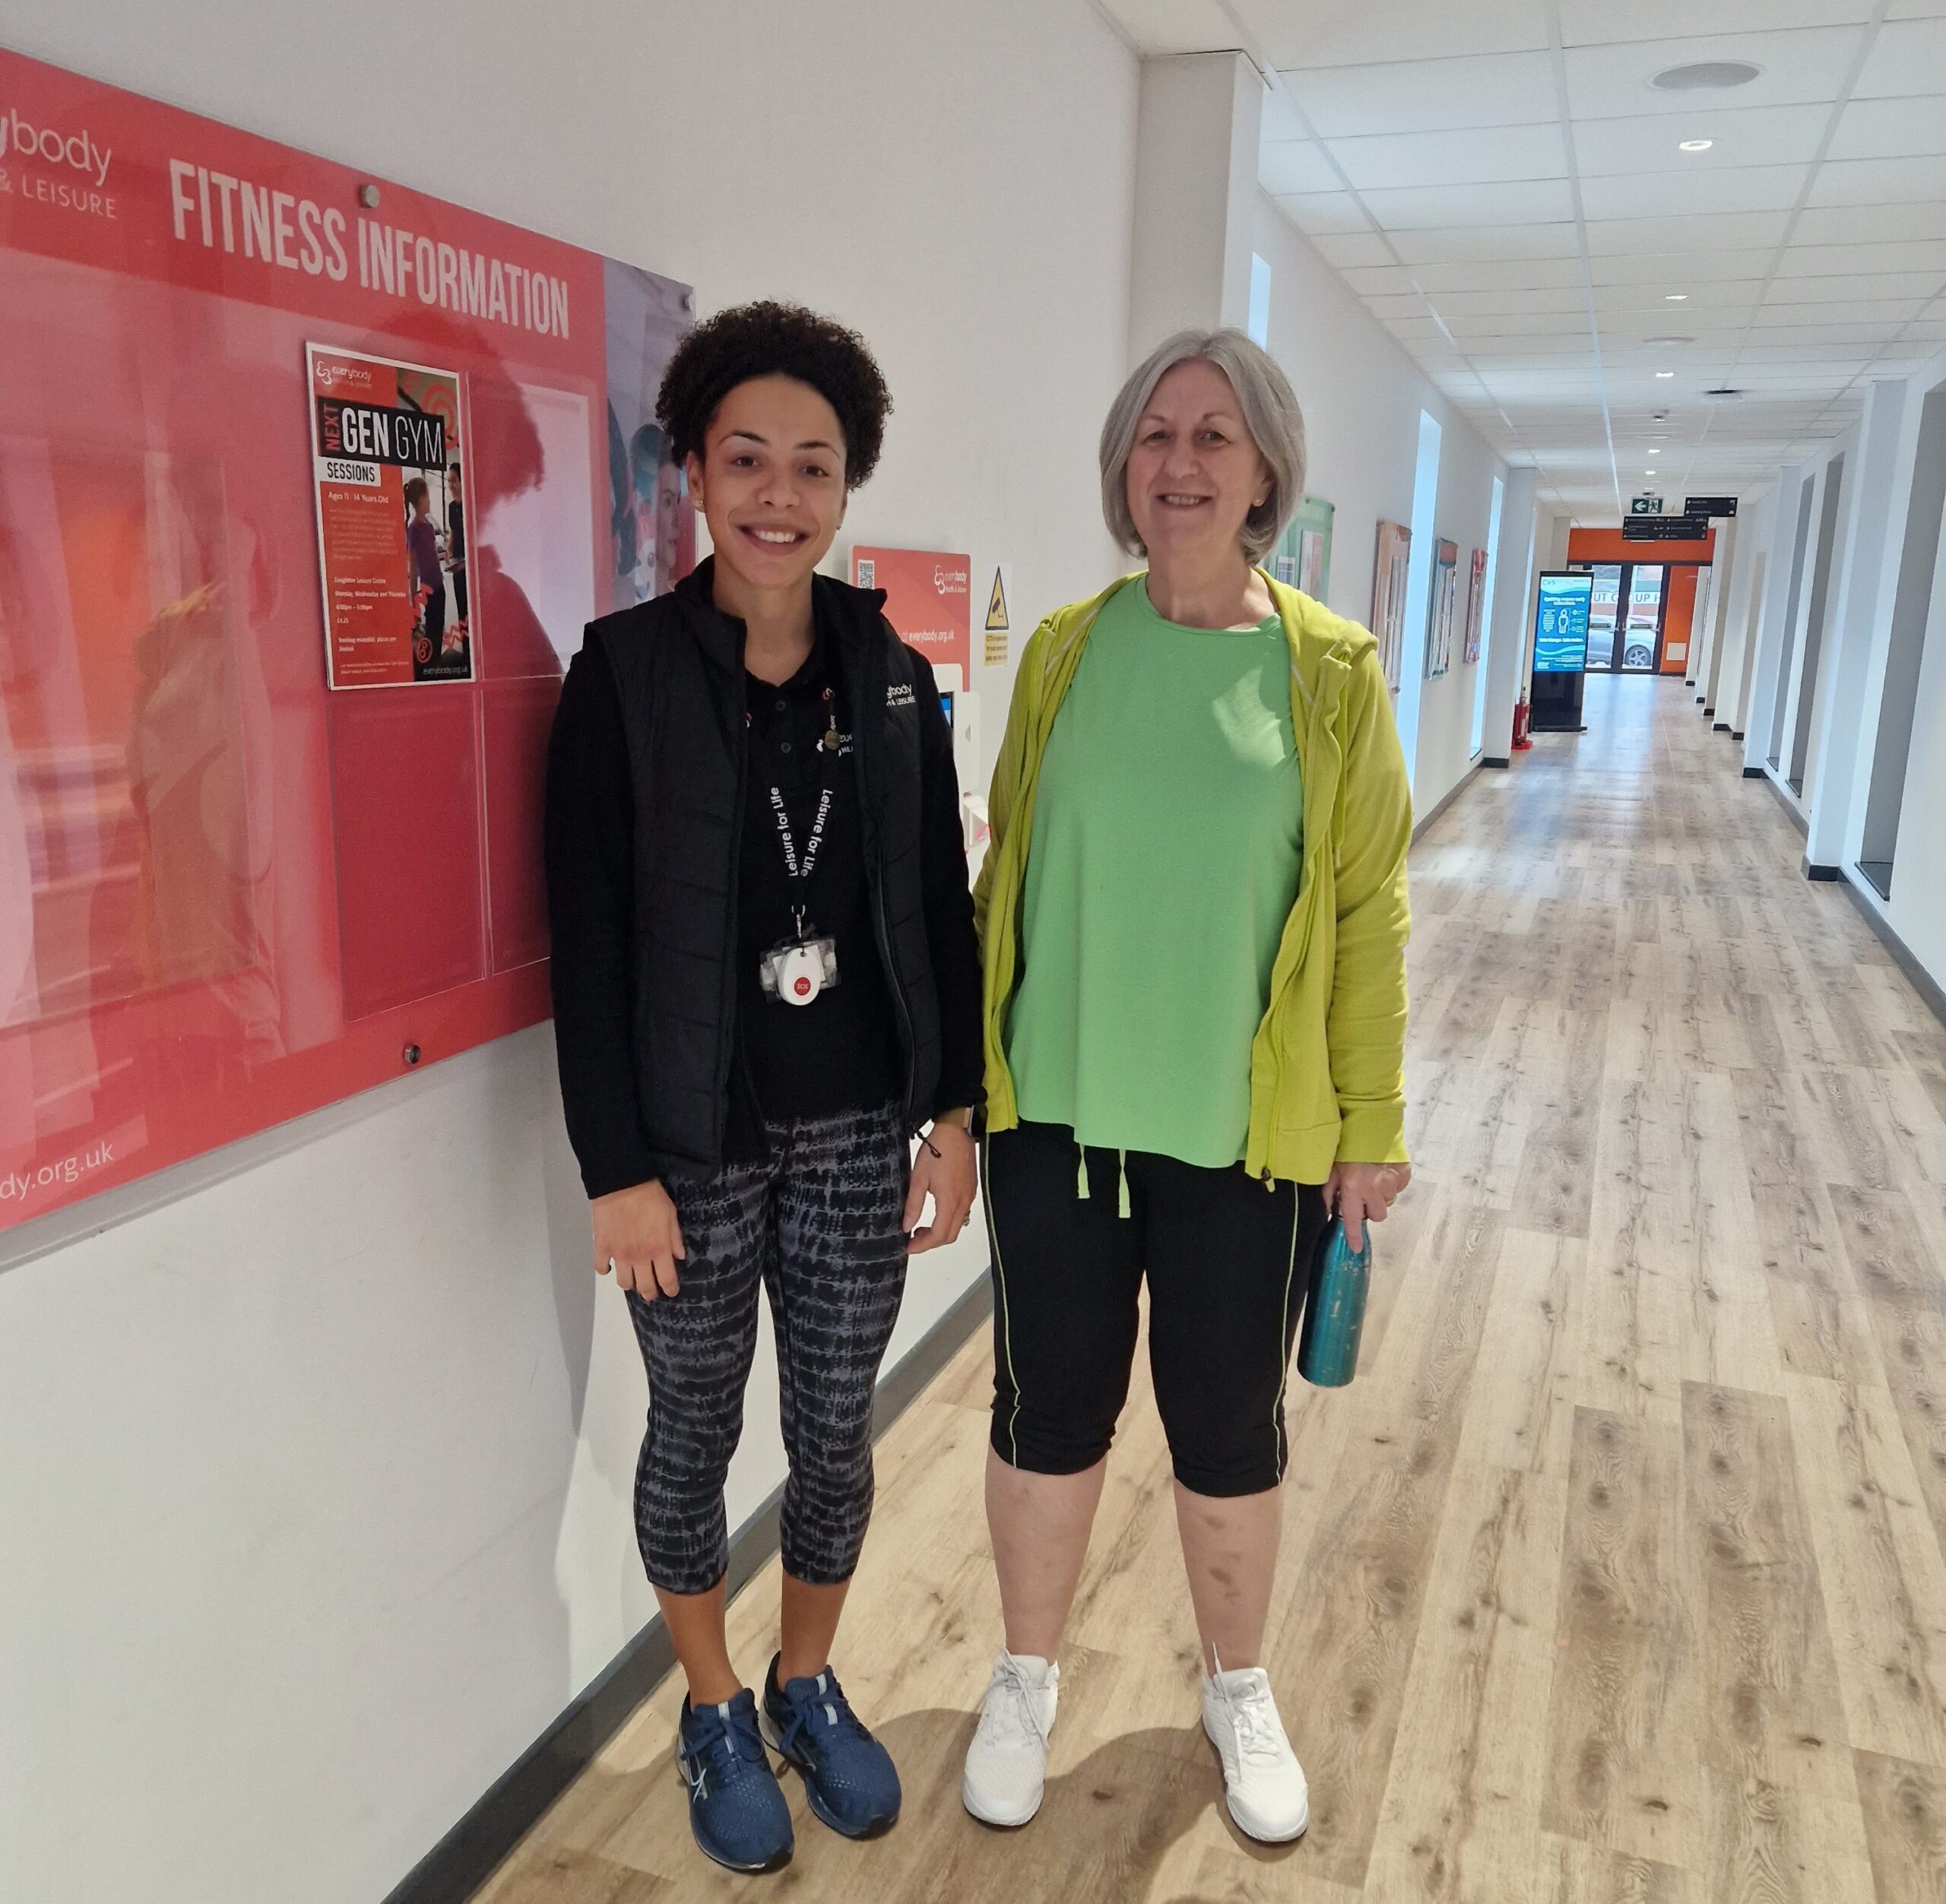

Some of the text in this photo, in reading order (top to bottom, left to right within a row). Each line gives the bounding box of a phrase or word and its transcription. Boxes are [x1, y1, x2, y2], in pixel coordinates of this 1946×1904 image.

[22, 173, 116, 219] LEISURE
[169, 157, 569, 341] FITNESS INFORMATION
[323, 402, 341, 452] NEXT
[342, 407, 442, 464] GEN GYM
[327, 461, 376, 483] SESSIONS
[328, 491, 343, 502] Ages
[353, 493, 360, 502] 14
[360, 494, 378, 503] Years
[378, 495, 389, 504] Old
[908, 628, 955, 644] everybody.org.uk
[770, 787, 799, 876] Leisure for Life
[800, 789, 833, 877] Leisure for Life
